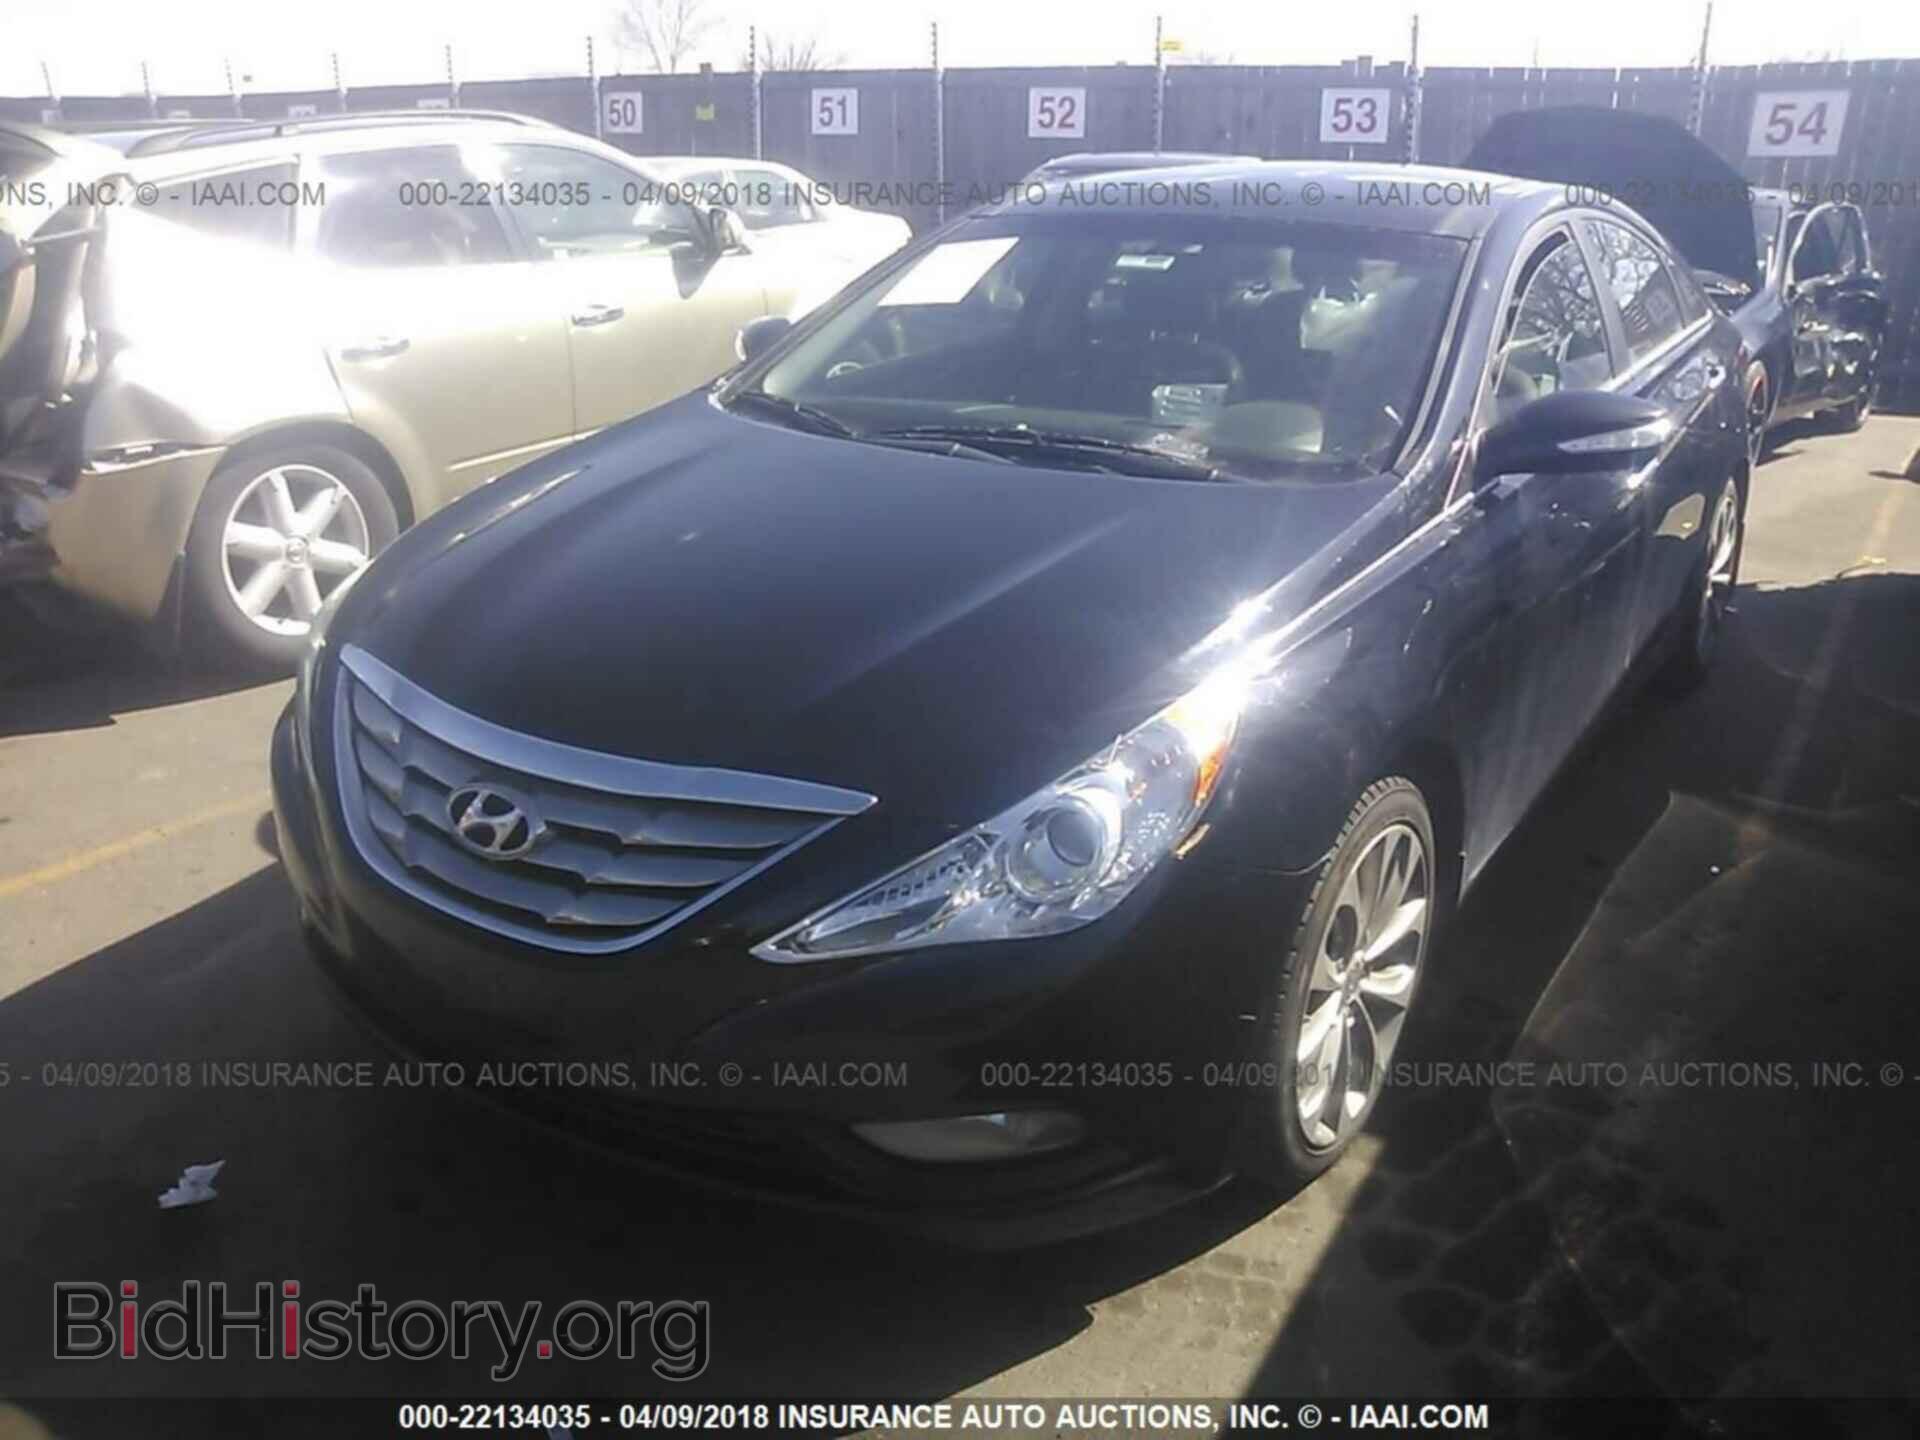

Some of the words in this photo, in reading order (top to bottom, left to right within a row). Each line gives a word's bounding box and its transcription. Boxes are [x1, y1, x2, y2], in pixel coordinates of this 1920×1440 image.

[608, 98, 637, 128] 50
[817, 97, 849, 128] 51
[1037, 96, 1076, 130] 52
[1331, 97, 1378, 133] 53
[1764, 101, 1828, 145] 54
